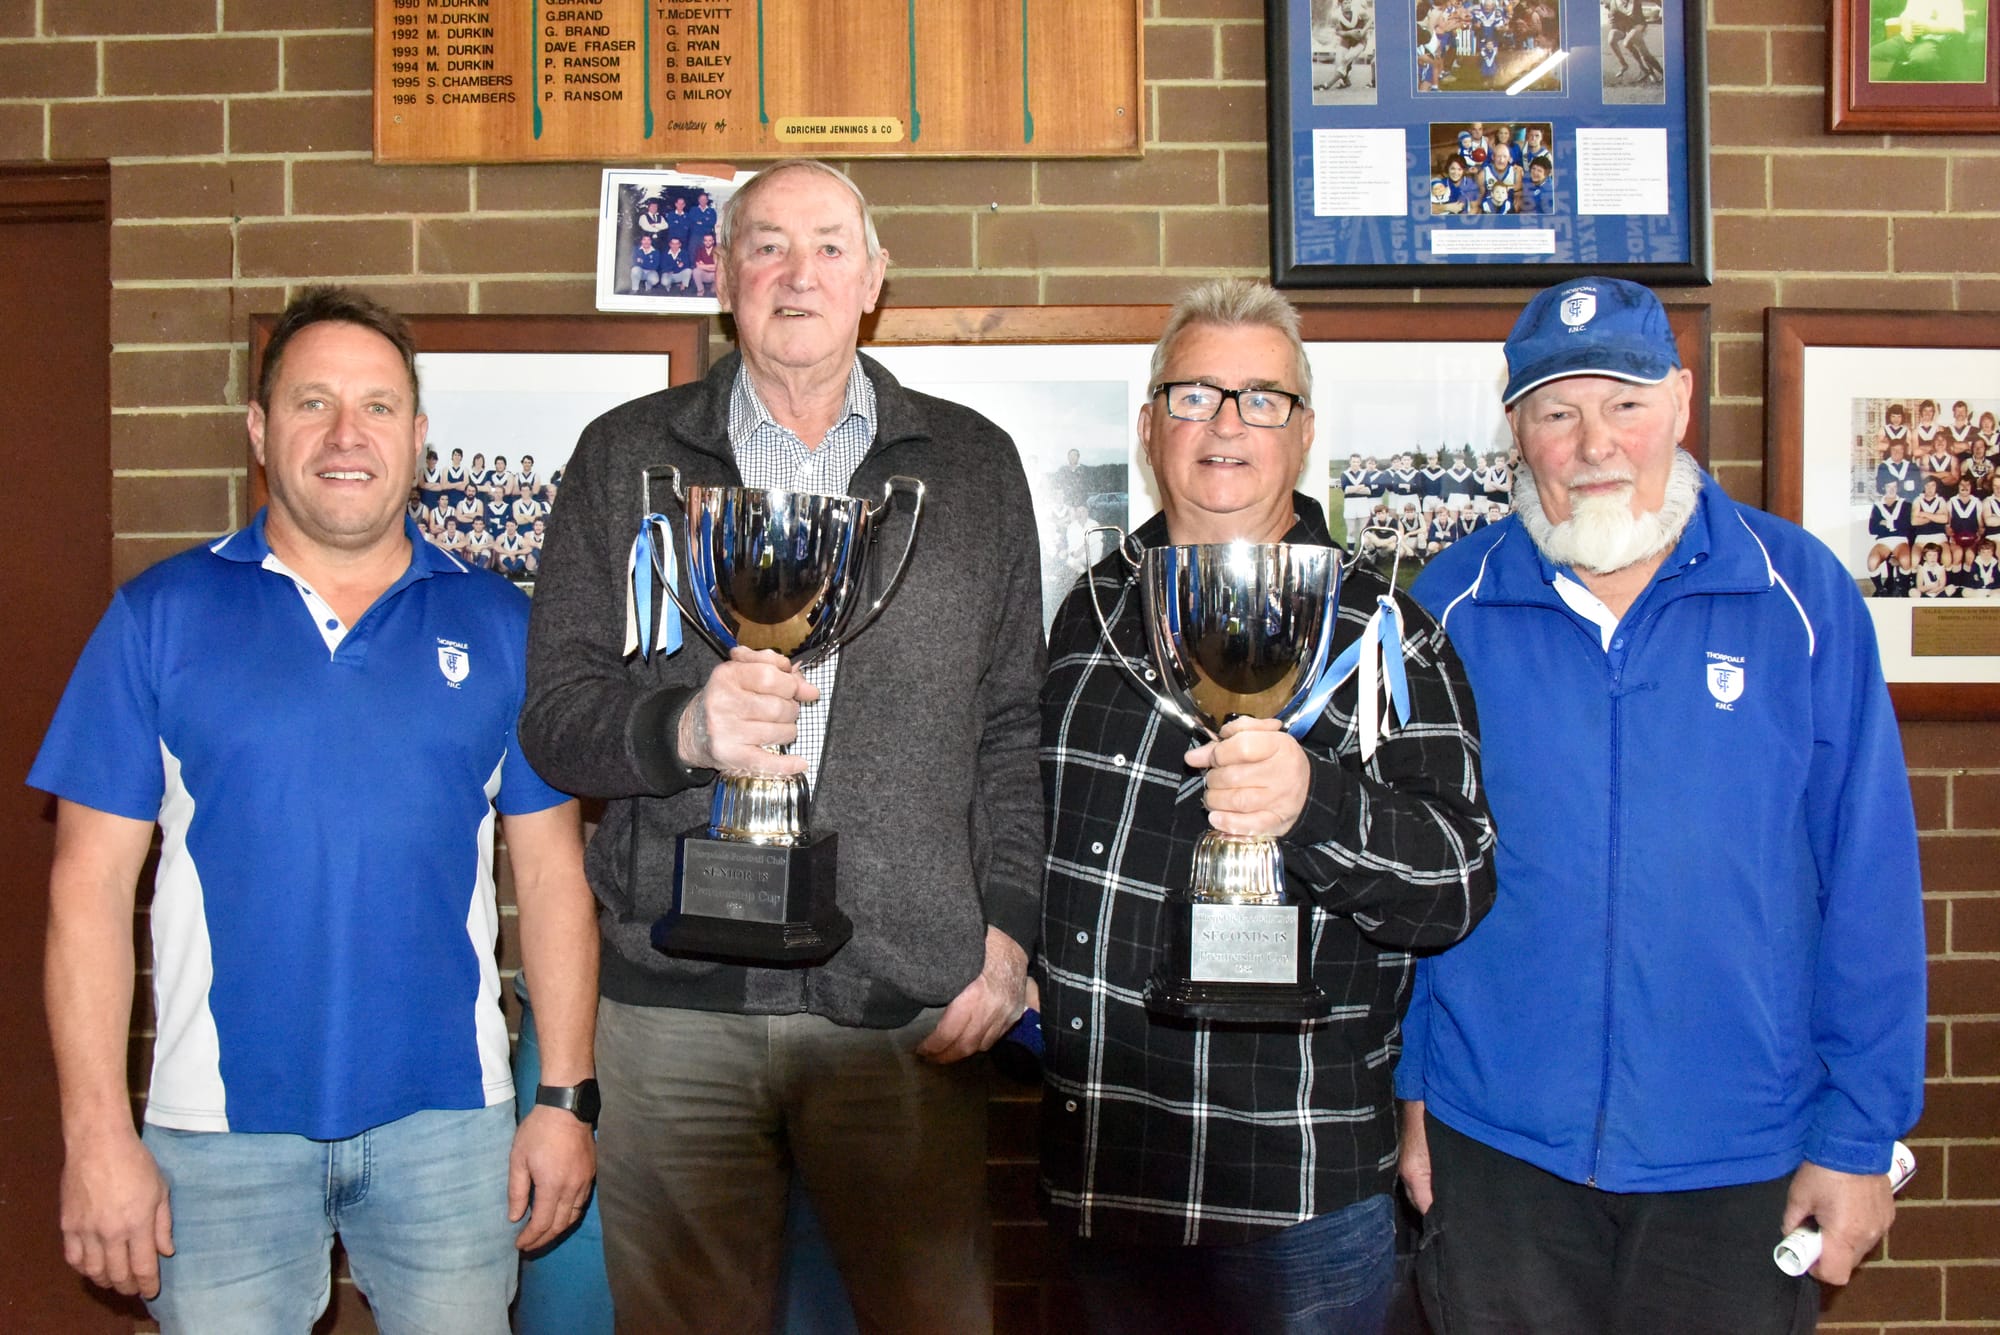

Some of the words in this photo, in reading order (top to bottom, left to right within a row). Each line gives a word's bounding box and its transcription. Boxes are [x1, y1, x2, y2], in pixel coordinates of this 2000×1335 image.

[394, 15, 418, 25] 1991
[392, 28, 418, 40] 1992
[427, 29, 440, 39] M.
[447, 28, 494, 39] DURKIN
[545, 26, 558, 37] G.
[565, 26, 610, 36] BRAND
[666, 25, 679, 36] G.
[687, 24, 719, 36] RYAN
[392, 46, 418, 57] 1993
[427, 45, 440, 56] M.
[447, 44, 494, 56] DURKIN
[545, 41, 577, 53] DAVE
[584, 40, 636, 52] FRASER
[666, 41, 680, 52] G.
[687, 40, 720, 51] RYAN
[392, 62, 419, 72] 1994
[427, 61, 440, 72] M.
[447, 60, 494, 71] DURKIN
[544, 57, 556, 69] P.
[564, 56, 620, 67] RANSOM
[666, 57, 679, 68] B.
[686, 56, 732, 67] BAILEY
[392, 77, 420, 88] 1995
[442, 75, 513, 87] CHAMBERS
[544, 74, 556, 85] P.
[564, 73, 620, 84] RANSOM
[680, 72, 725, 83] BAILEY
[393, 94, 417, 105] 1996
[442, 92, 516, 104] CHAMBERS
[544, 91, 556, 102] P.
[564, 90, 623, 102] RANSOM
[683, 89, 732, 100] MILROY
[786, 125, 827, 134] ADRICHEM
[830, 125, 869, 134] JENNINGS
[872, 125, 877, 134] &
[881, 125, 892, 134] CO
[767, 856, 786, 866] Club
[759, 891, 781, 907] Cup
[1202, 930, 1269, 942] SECONDS
